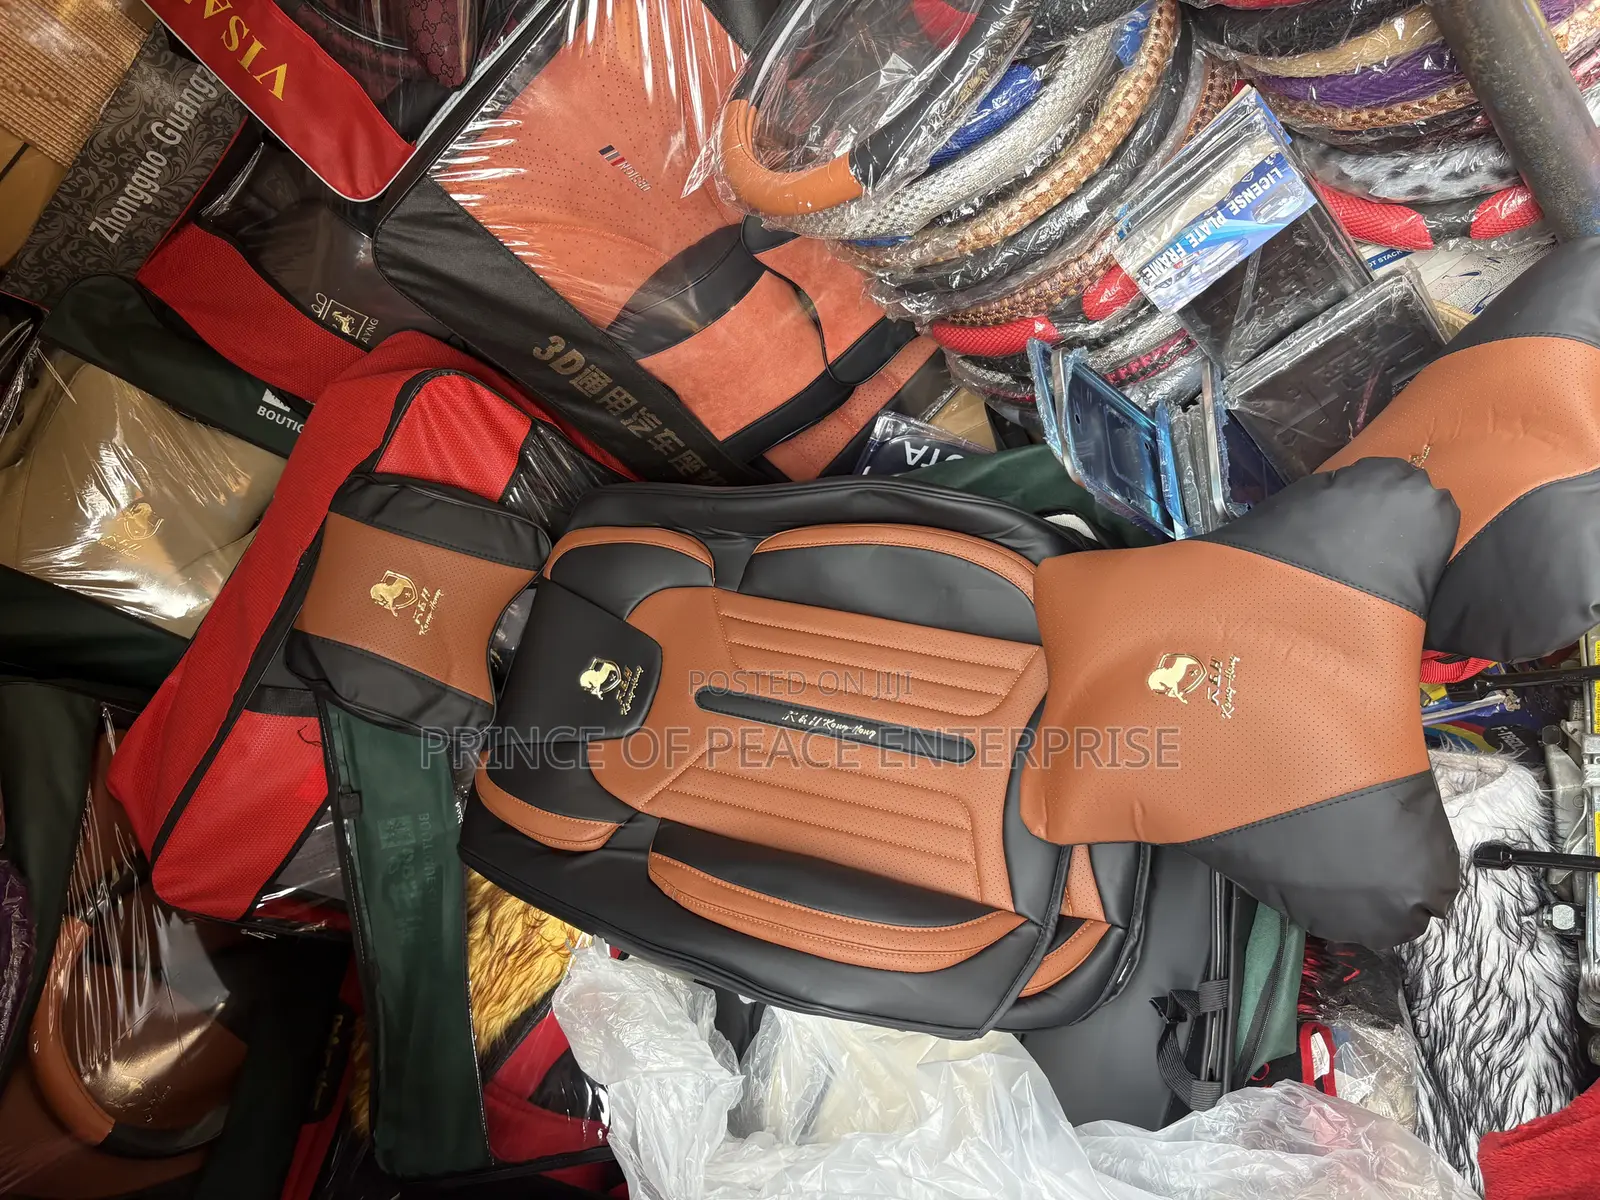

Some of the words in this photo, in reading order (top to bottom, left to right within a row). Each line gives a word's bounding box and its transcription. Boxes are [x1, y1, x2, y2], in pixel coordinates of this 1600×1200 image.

[183, 0, 286, 101] VISA
[88, 150, 168, 243] Zhongguo
[1228, 167, 1284, 216] LICENSE
[1185, 211, 1229, 249] PLATE
[1142, 243, 1188, 282] FRAME
